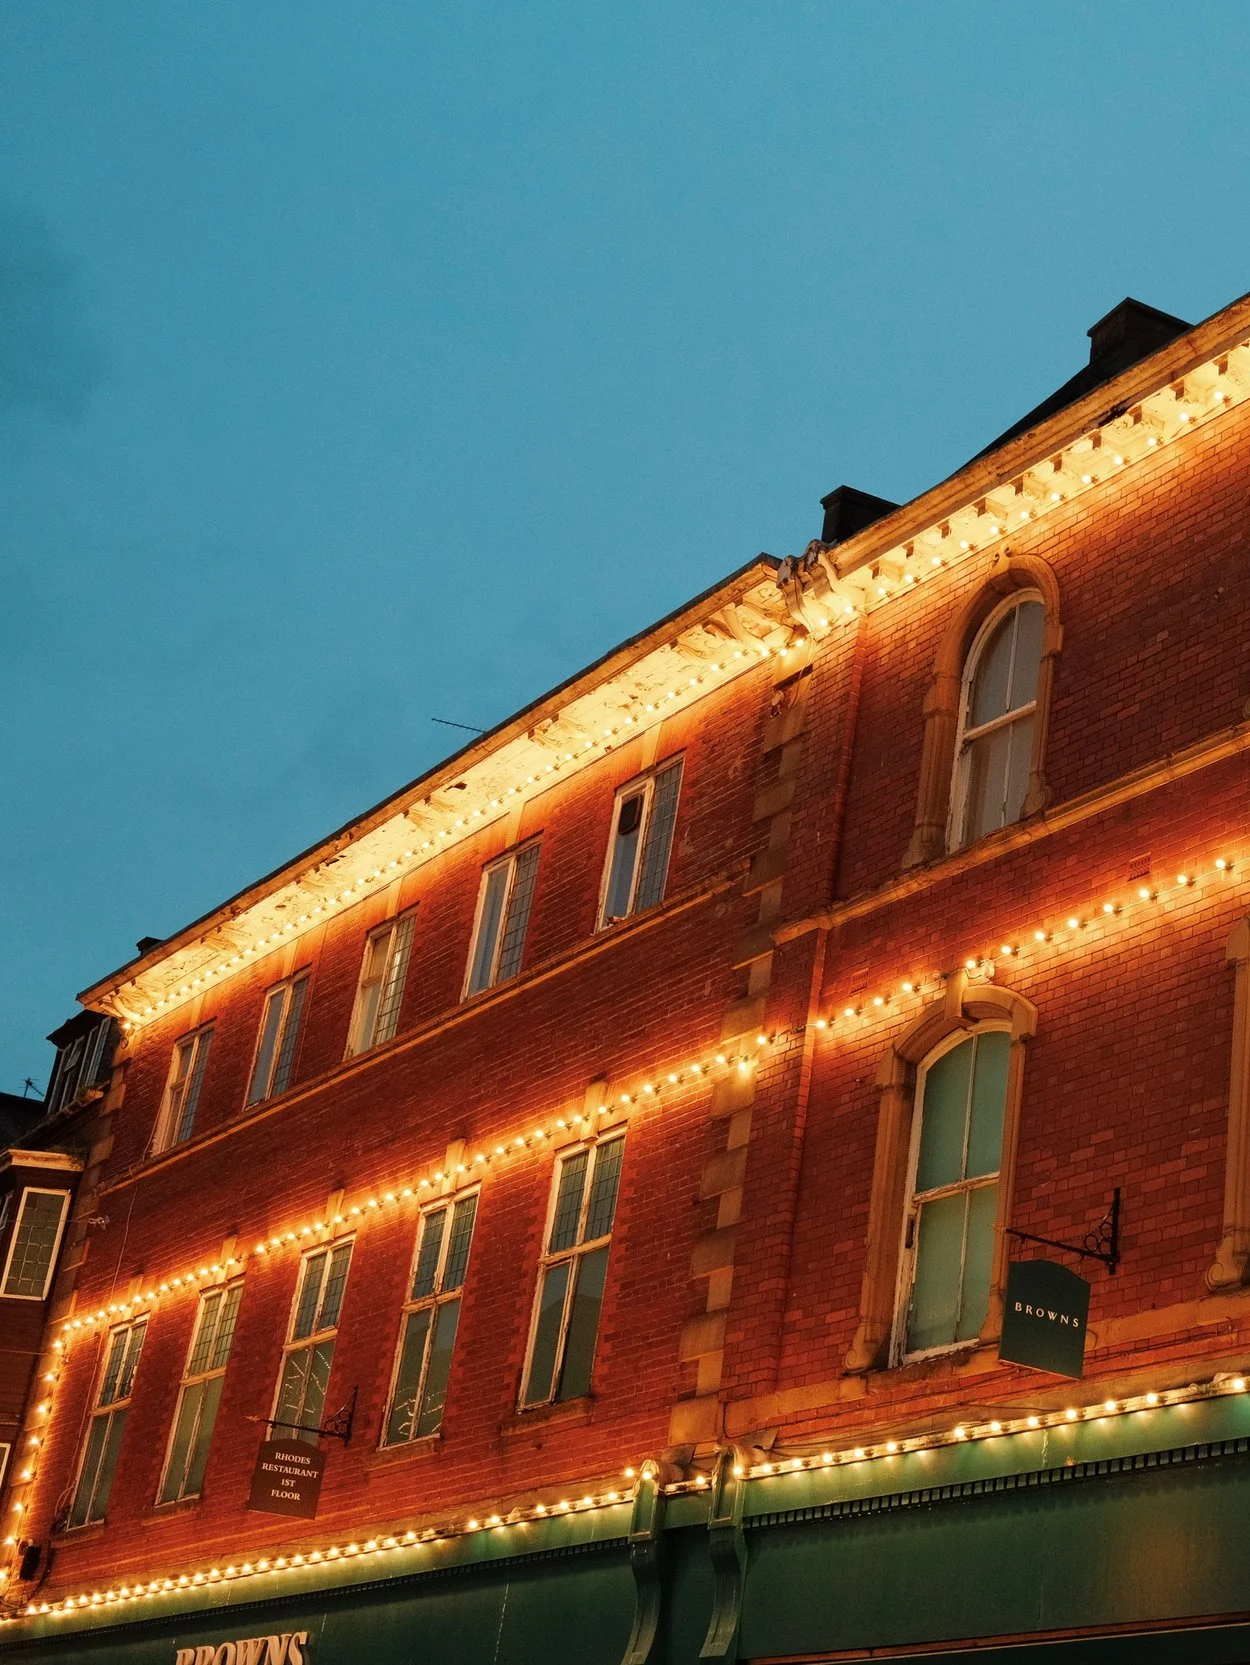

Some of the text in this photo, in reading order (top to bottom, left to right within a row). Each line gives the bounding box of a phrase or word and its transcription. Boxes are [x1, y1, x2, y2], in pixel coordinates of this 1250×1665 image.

[1014, 1301, 1080, 1328] BROWNS
[275, 1452, 311, 1465] RHODES
[262, 1462, 319, 1479] RESTAURANT
[271, 1489, 301, 1501] FLOOR
